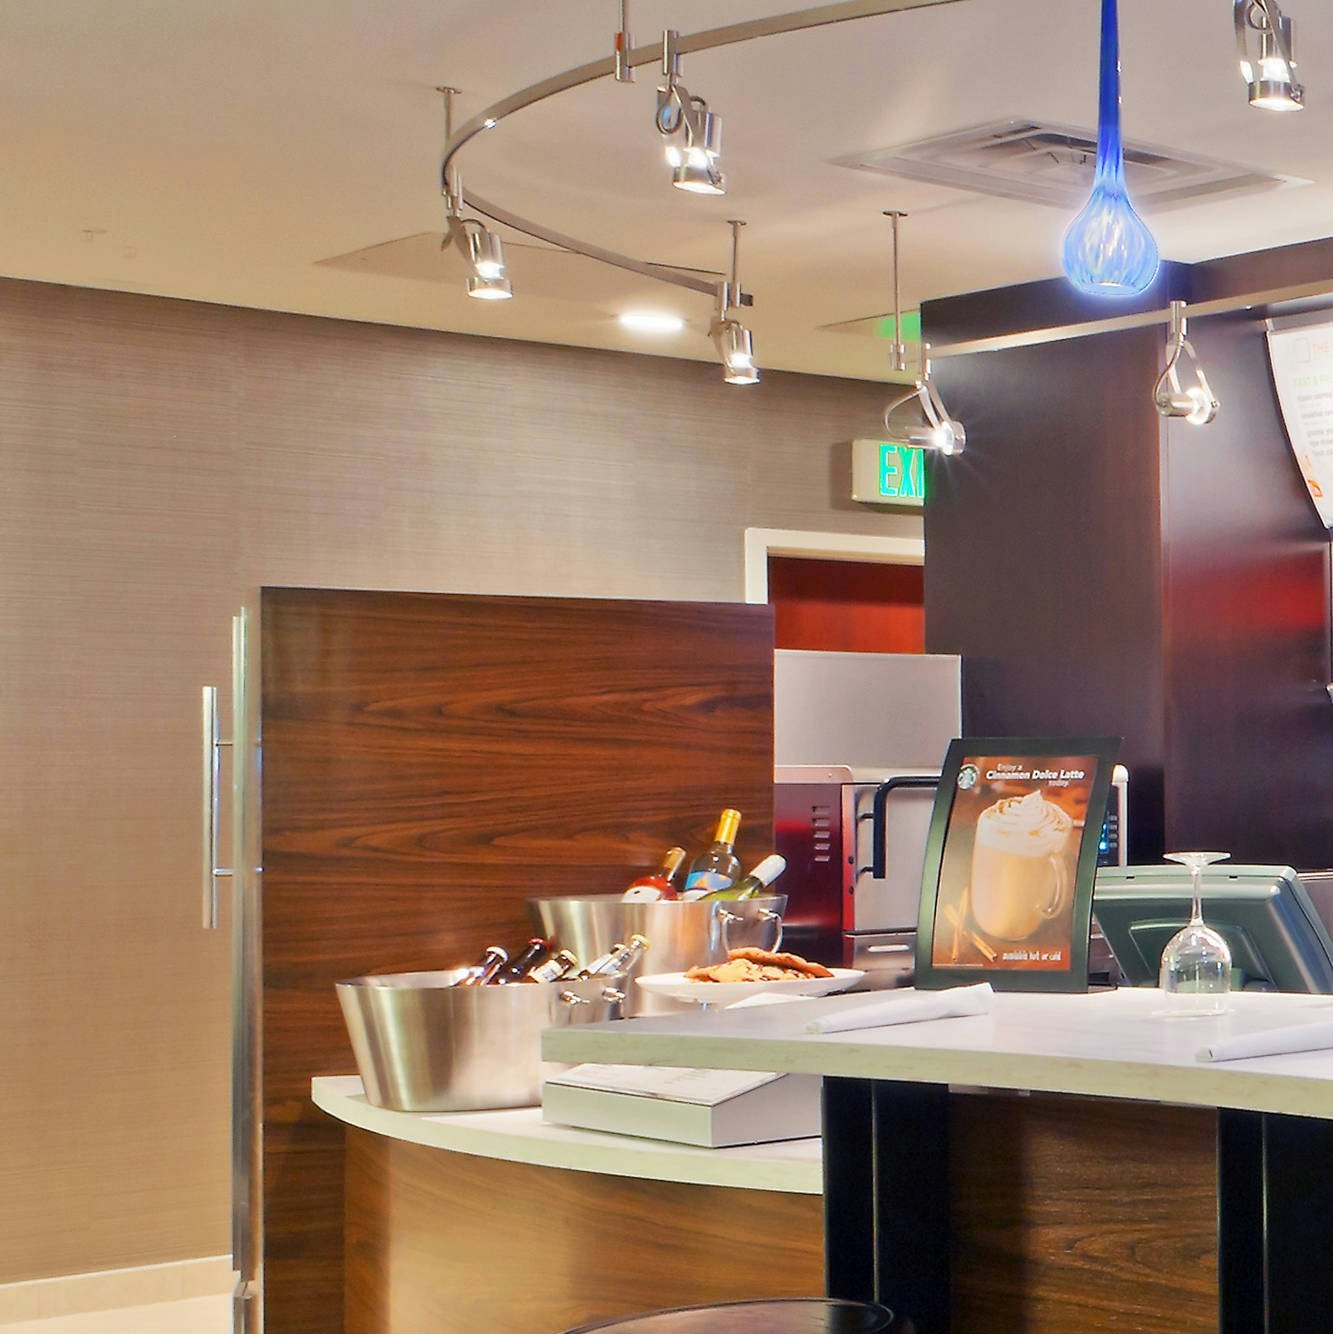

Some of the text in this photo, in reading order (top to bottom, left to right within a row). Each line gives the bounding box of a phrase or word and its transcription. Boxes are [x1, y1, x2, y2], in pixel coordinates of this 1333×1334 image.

[879, 444, 924, 497] EXI
[986, 770, 1085, 779] Cinnamon Dolce Latte
